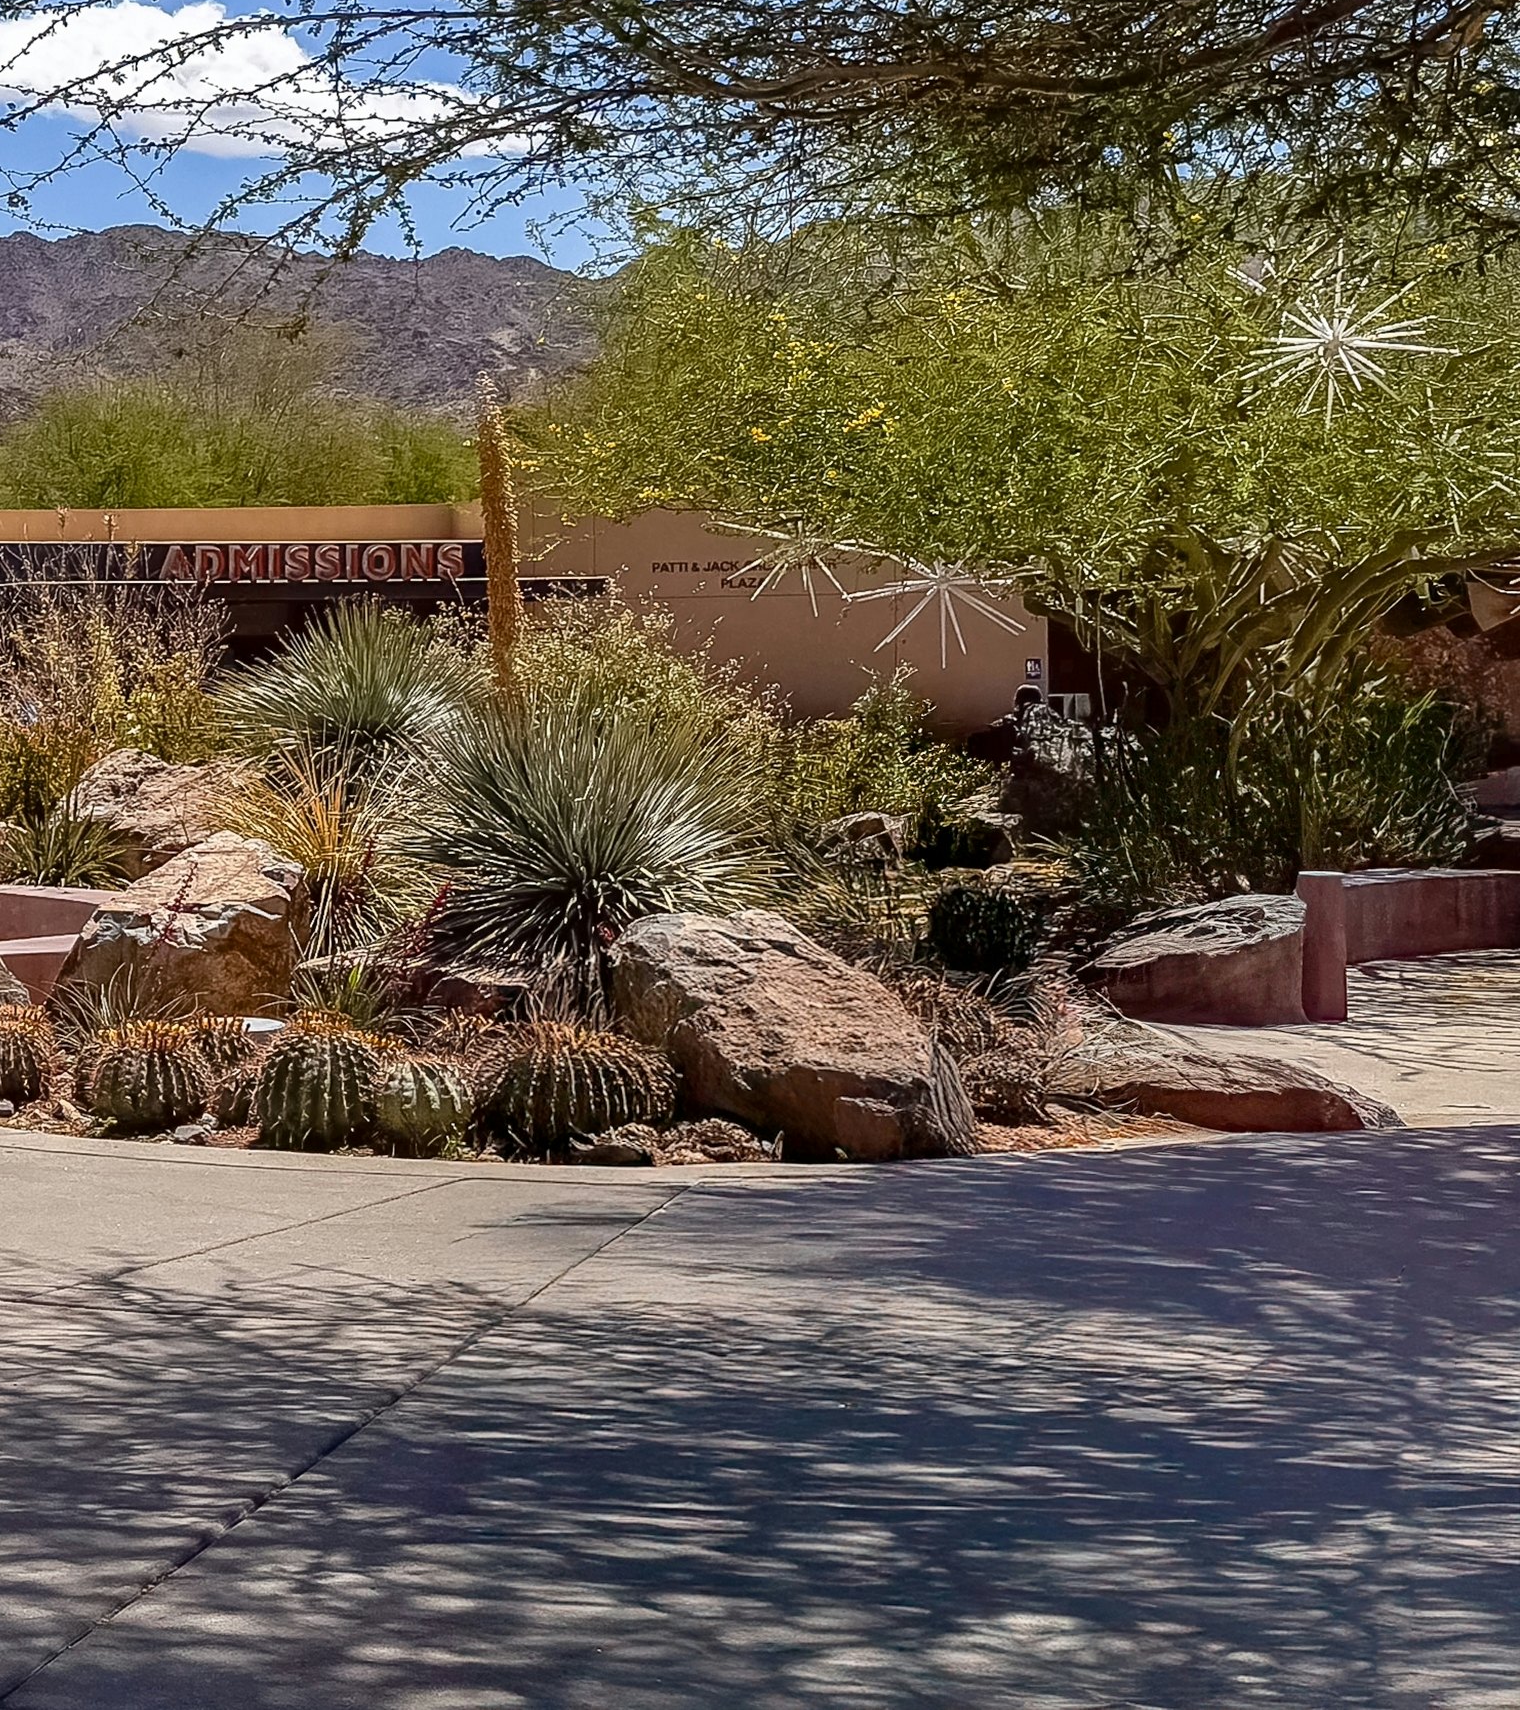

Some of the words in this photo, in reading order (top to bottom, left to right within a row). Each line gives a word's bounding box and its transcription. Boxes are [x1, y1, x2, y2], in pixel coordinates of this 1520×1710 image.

[161, 543, 465, 582] ADMISSIONS
[652, 561, 687, 573] PATTI
[691, 561, 700, 572] &
[703, 561, 738, 573] JACK
